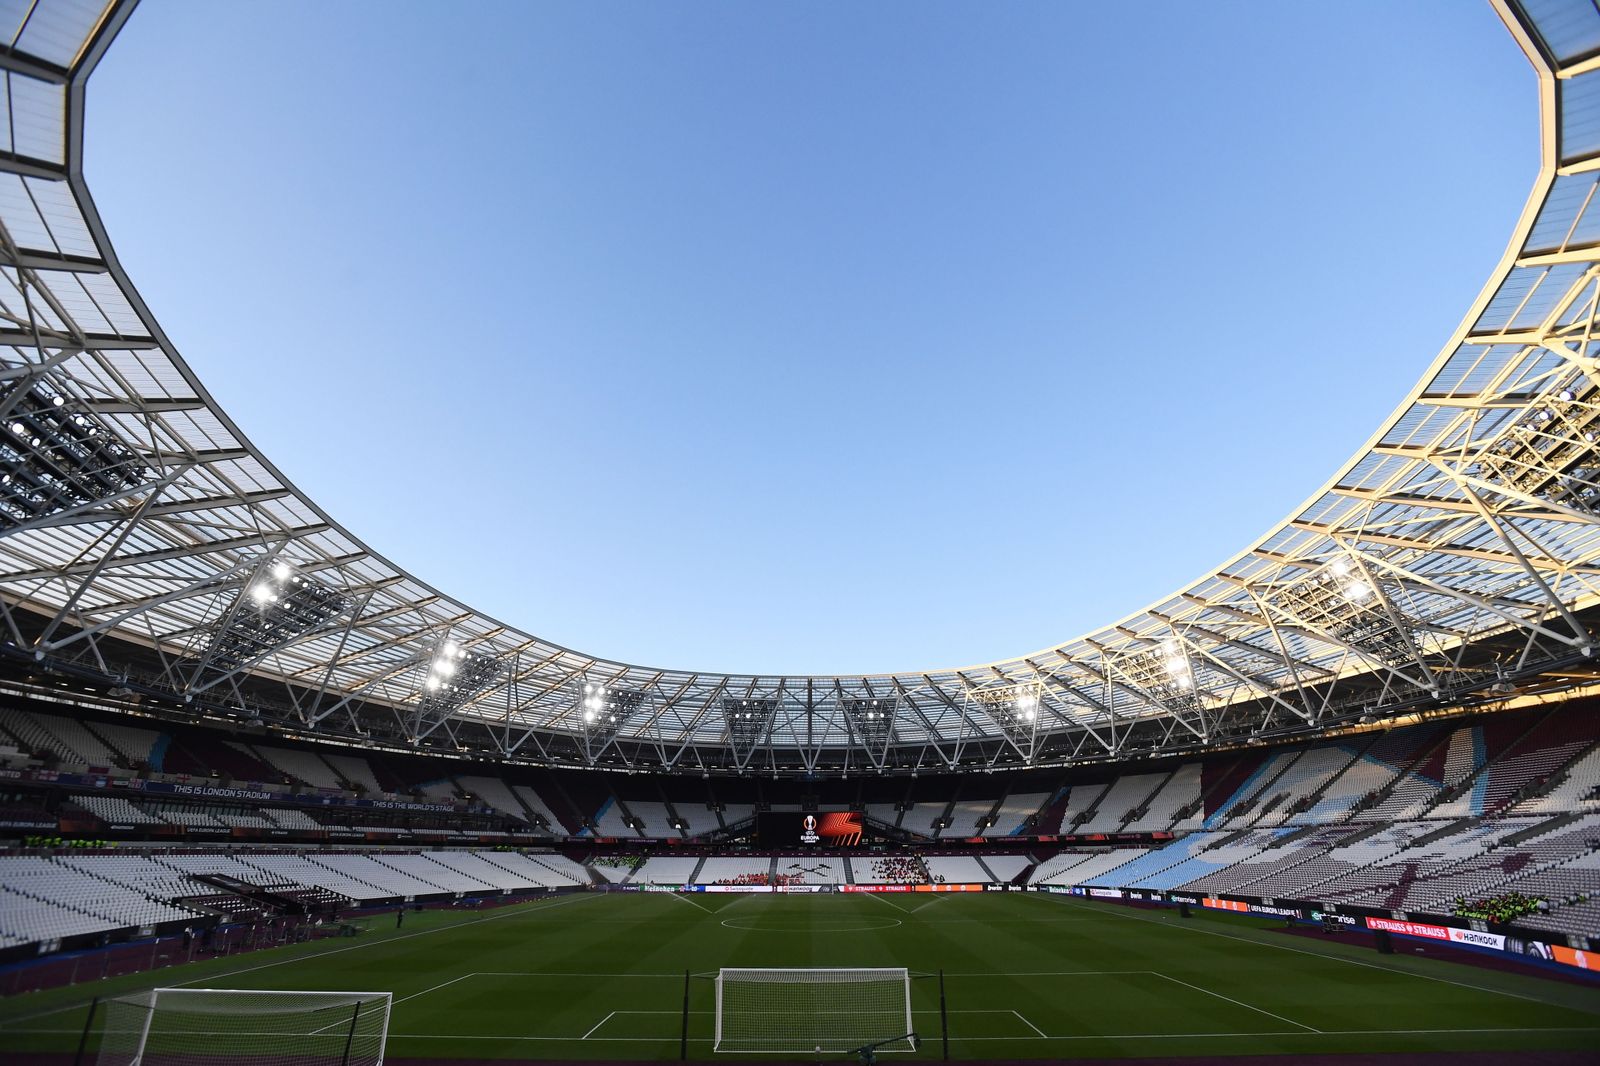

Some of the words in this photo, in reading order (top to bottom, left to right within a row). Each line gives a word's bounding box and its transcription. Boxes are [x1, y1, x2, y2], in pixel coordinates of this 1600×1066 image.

[174, 784, 193, 794] THIS
[193, 786, 202, 795] IS
[203, 787, 237, 797] LONDON
[237, 789, 271, 800] STADIUM
[372, 800, 387, 808] THIS
[387, 801, 394, 809] IS
[407, 802, 435, 811] WORLD'S
[436, 804, 455, 812] STAGE
[1130, 892, 1143, 900] bwin
[1150, 893, 1162, 901] bwin
[1251, 904, 1262, 912] UEFA
[1262, 905, 1278, 914] EUROPA
[1278, 907, 1296, 916] LEAGUE
[1376, 920, 1405, 931] STRAUSS
[1413, 924, 1447, 938] STRAUSS
